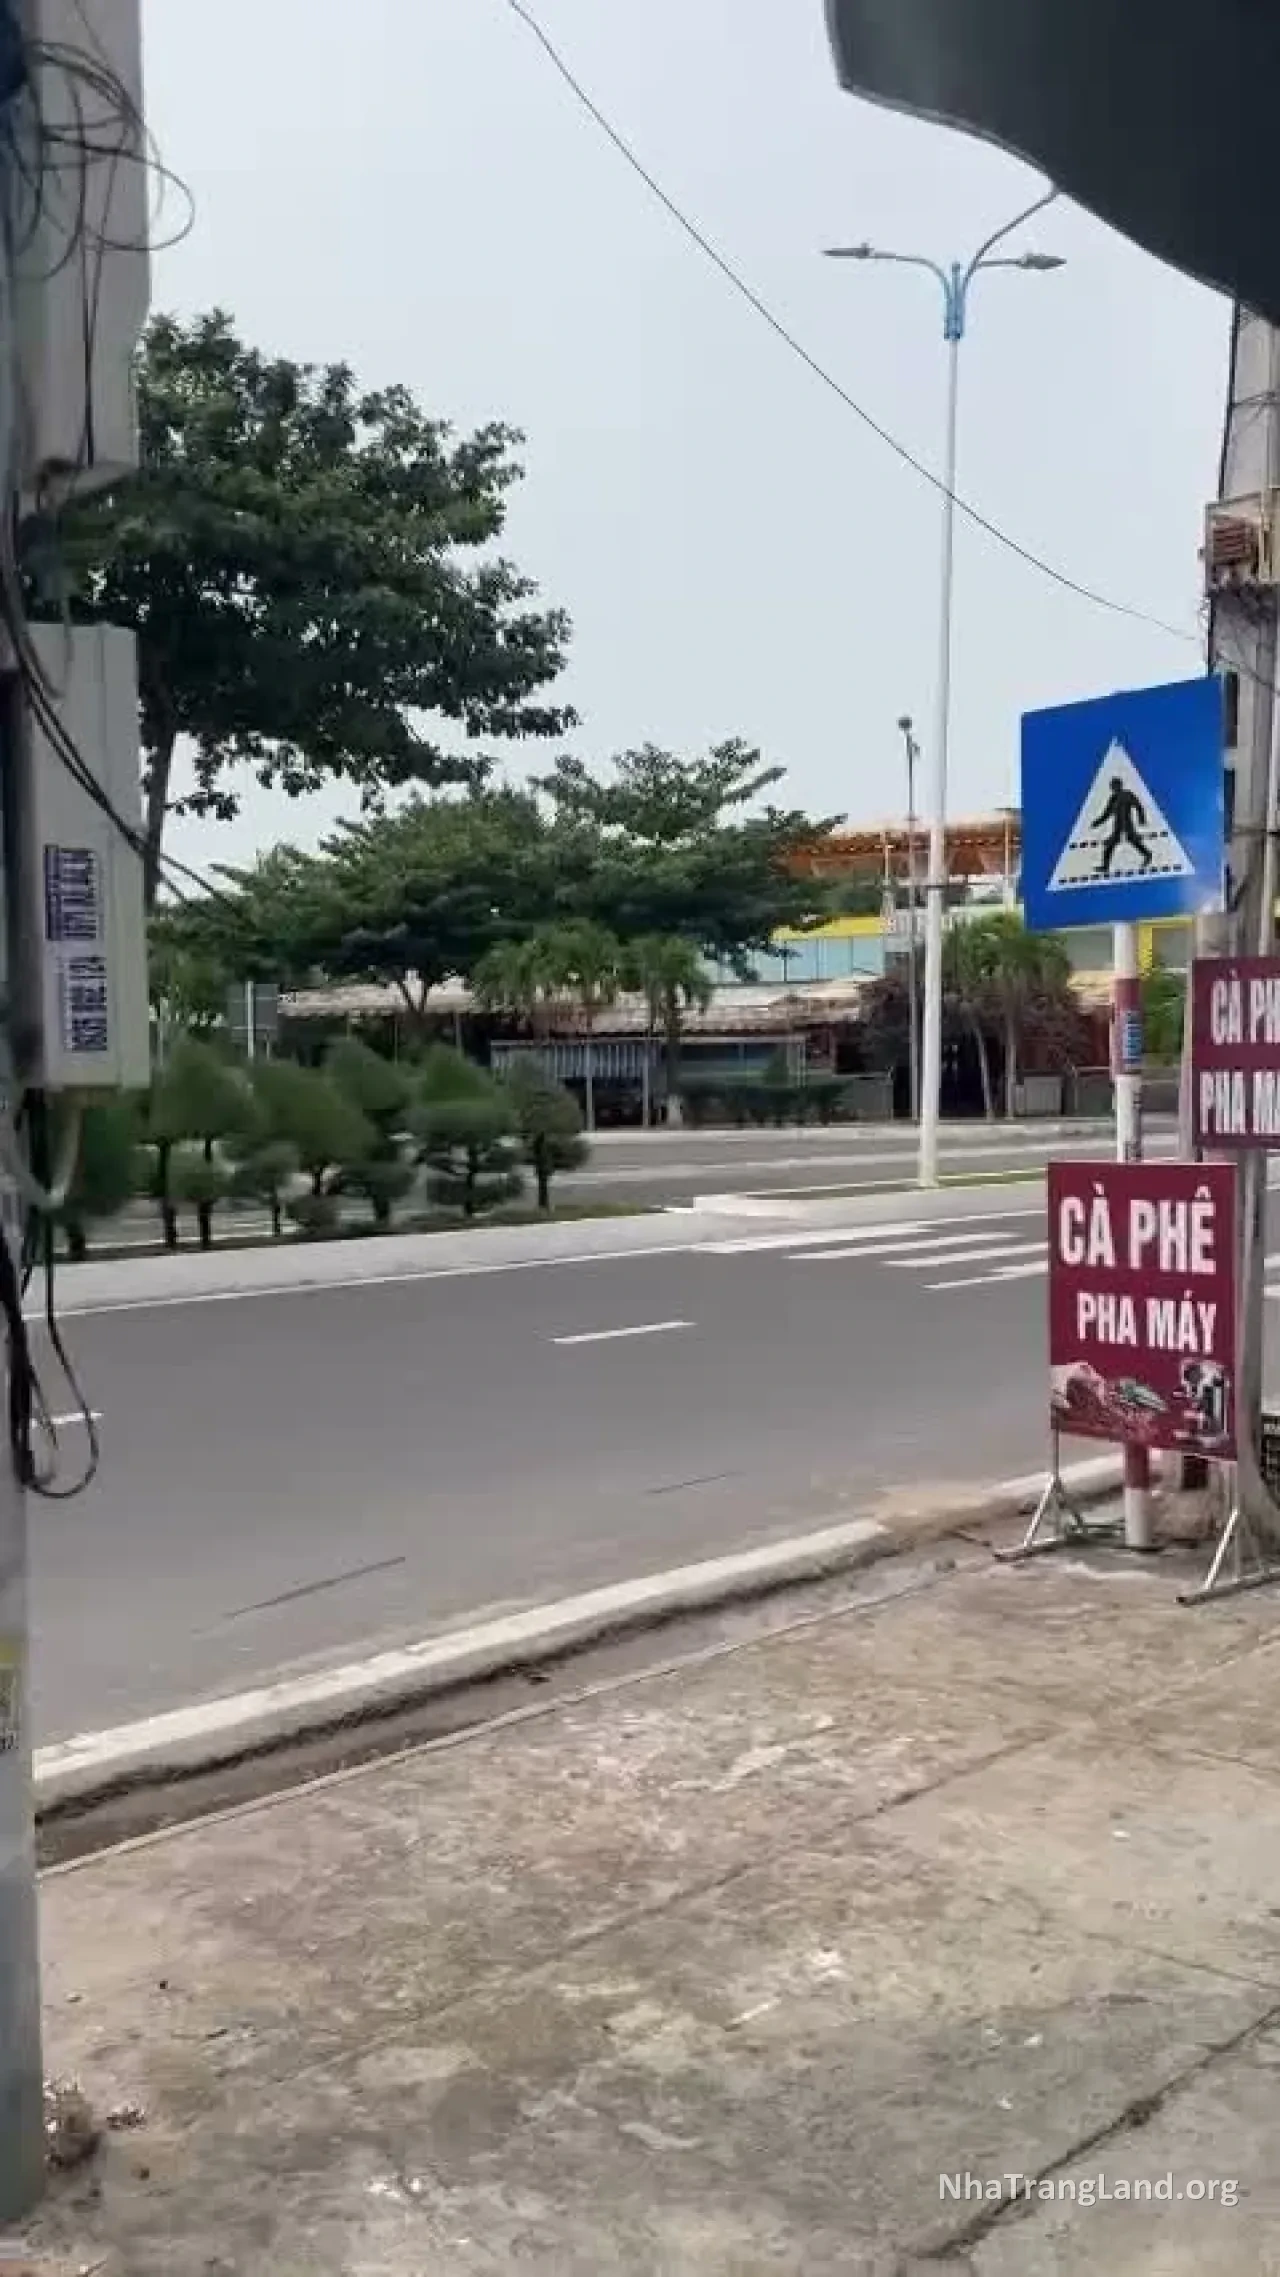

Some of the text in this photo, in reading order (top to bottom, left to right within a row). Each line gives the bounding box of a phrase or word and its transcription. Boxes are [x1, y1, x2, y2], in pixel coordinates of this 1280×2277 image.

[1211, 968, 1242, 1045] CÀ
[1250, 978, 1280, 1043] PH
[1200, 1071, 1246, 1133] PHA
[1060, 1183, 1217, 1274] CÀ PHÊ
[1077, 1290, 1217, 1354] PHA MÁY
